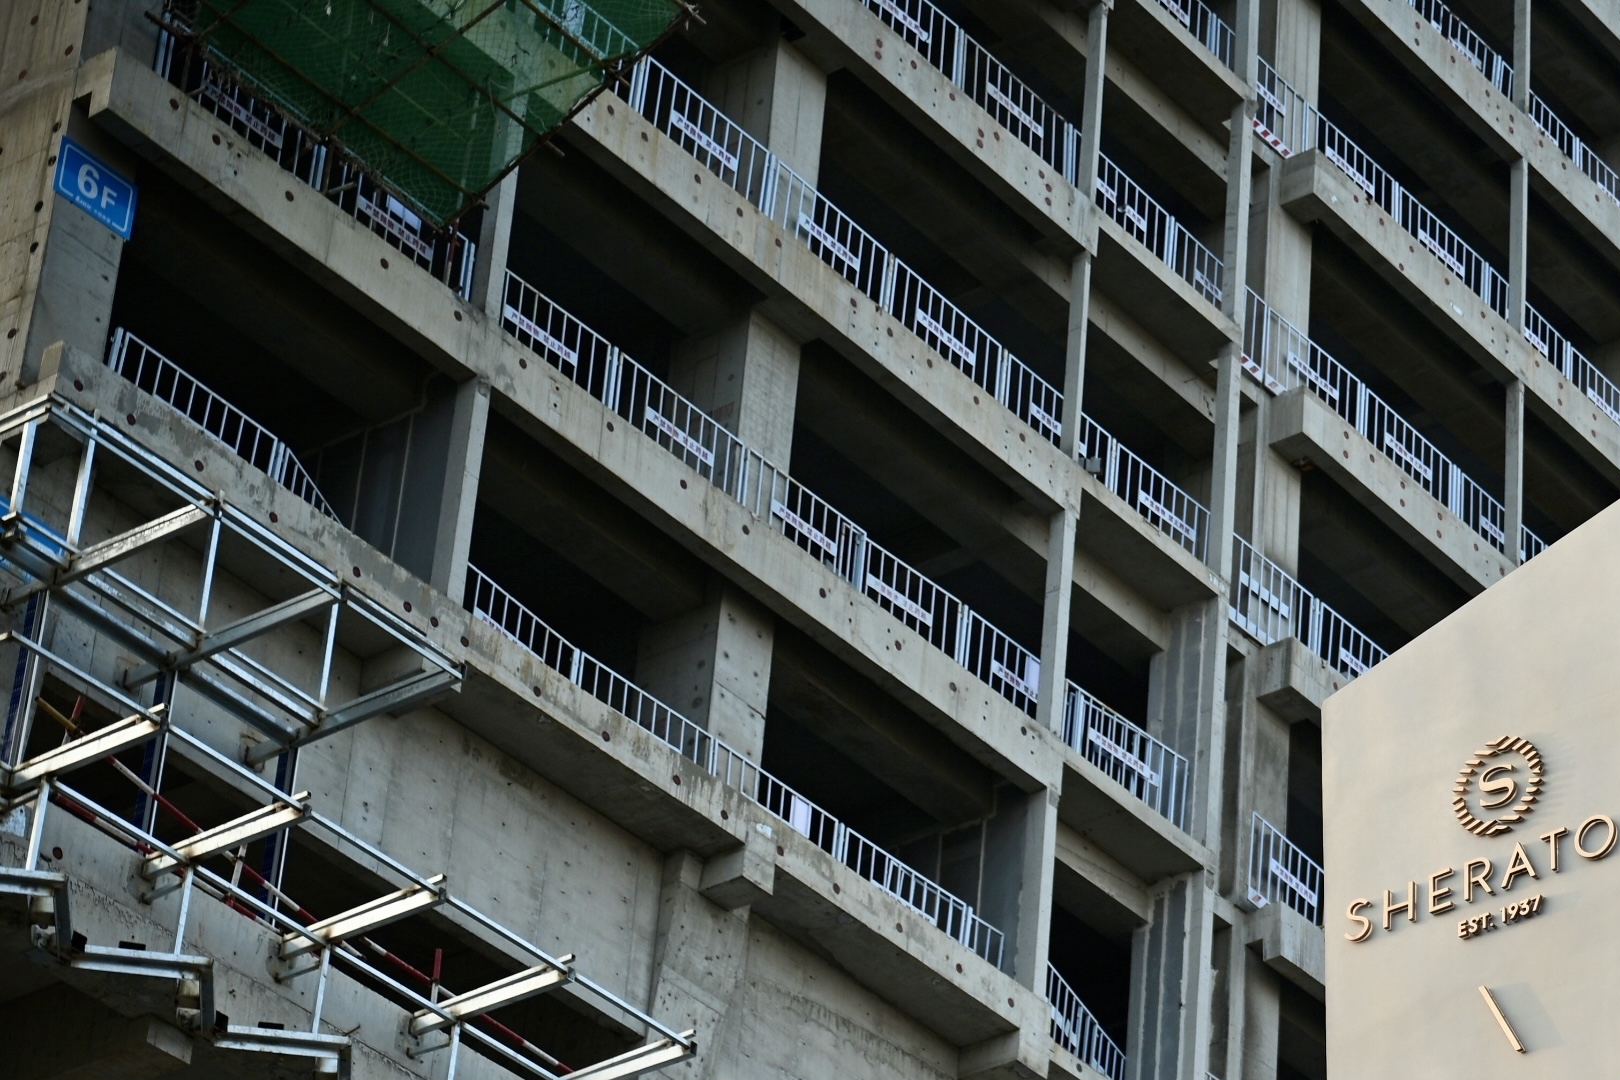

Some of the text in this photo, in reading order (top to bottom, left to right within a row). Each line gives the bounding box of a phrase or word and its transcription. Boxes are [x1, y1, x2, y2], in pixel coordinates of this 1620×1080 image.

[78, 163, 117, 210] 6F
[1456, 893, 1546, 940] EST. 1937
